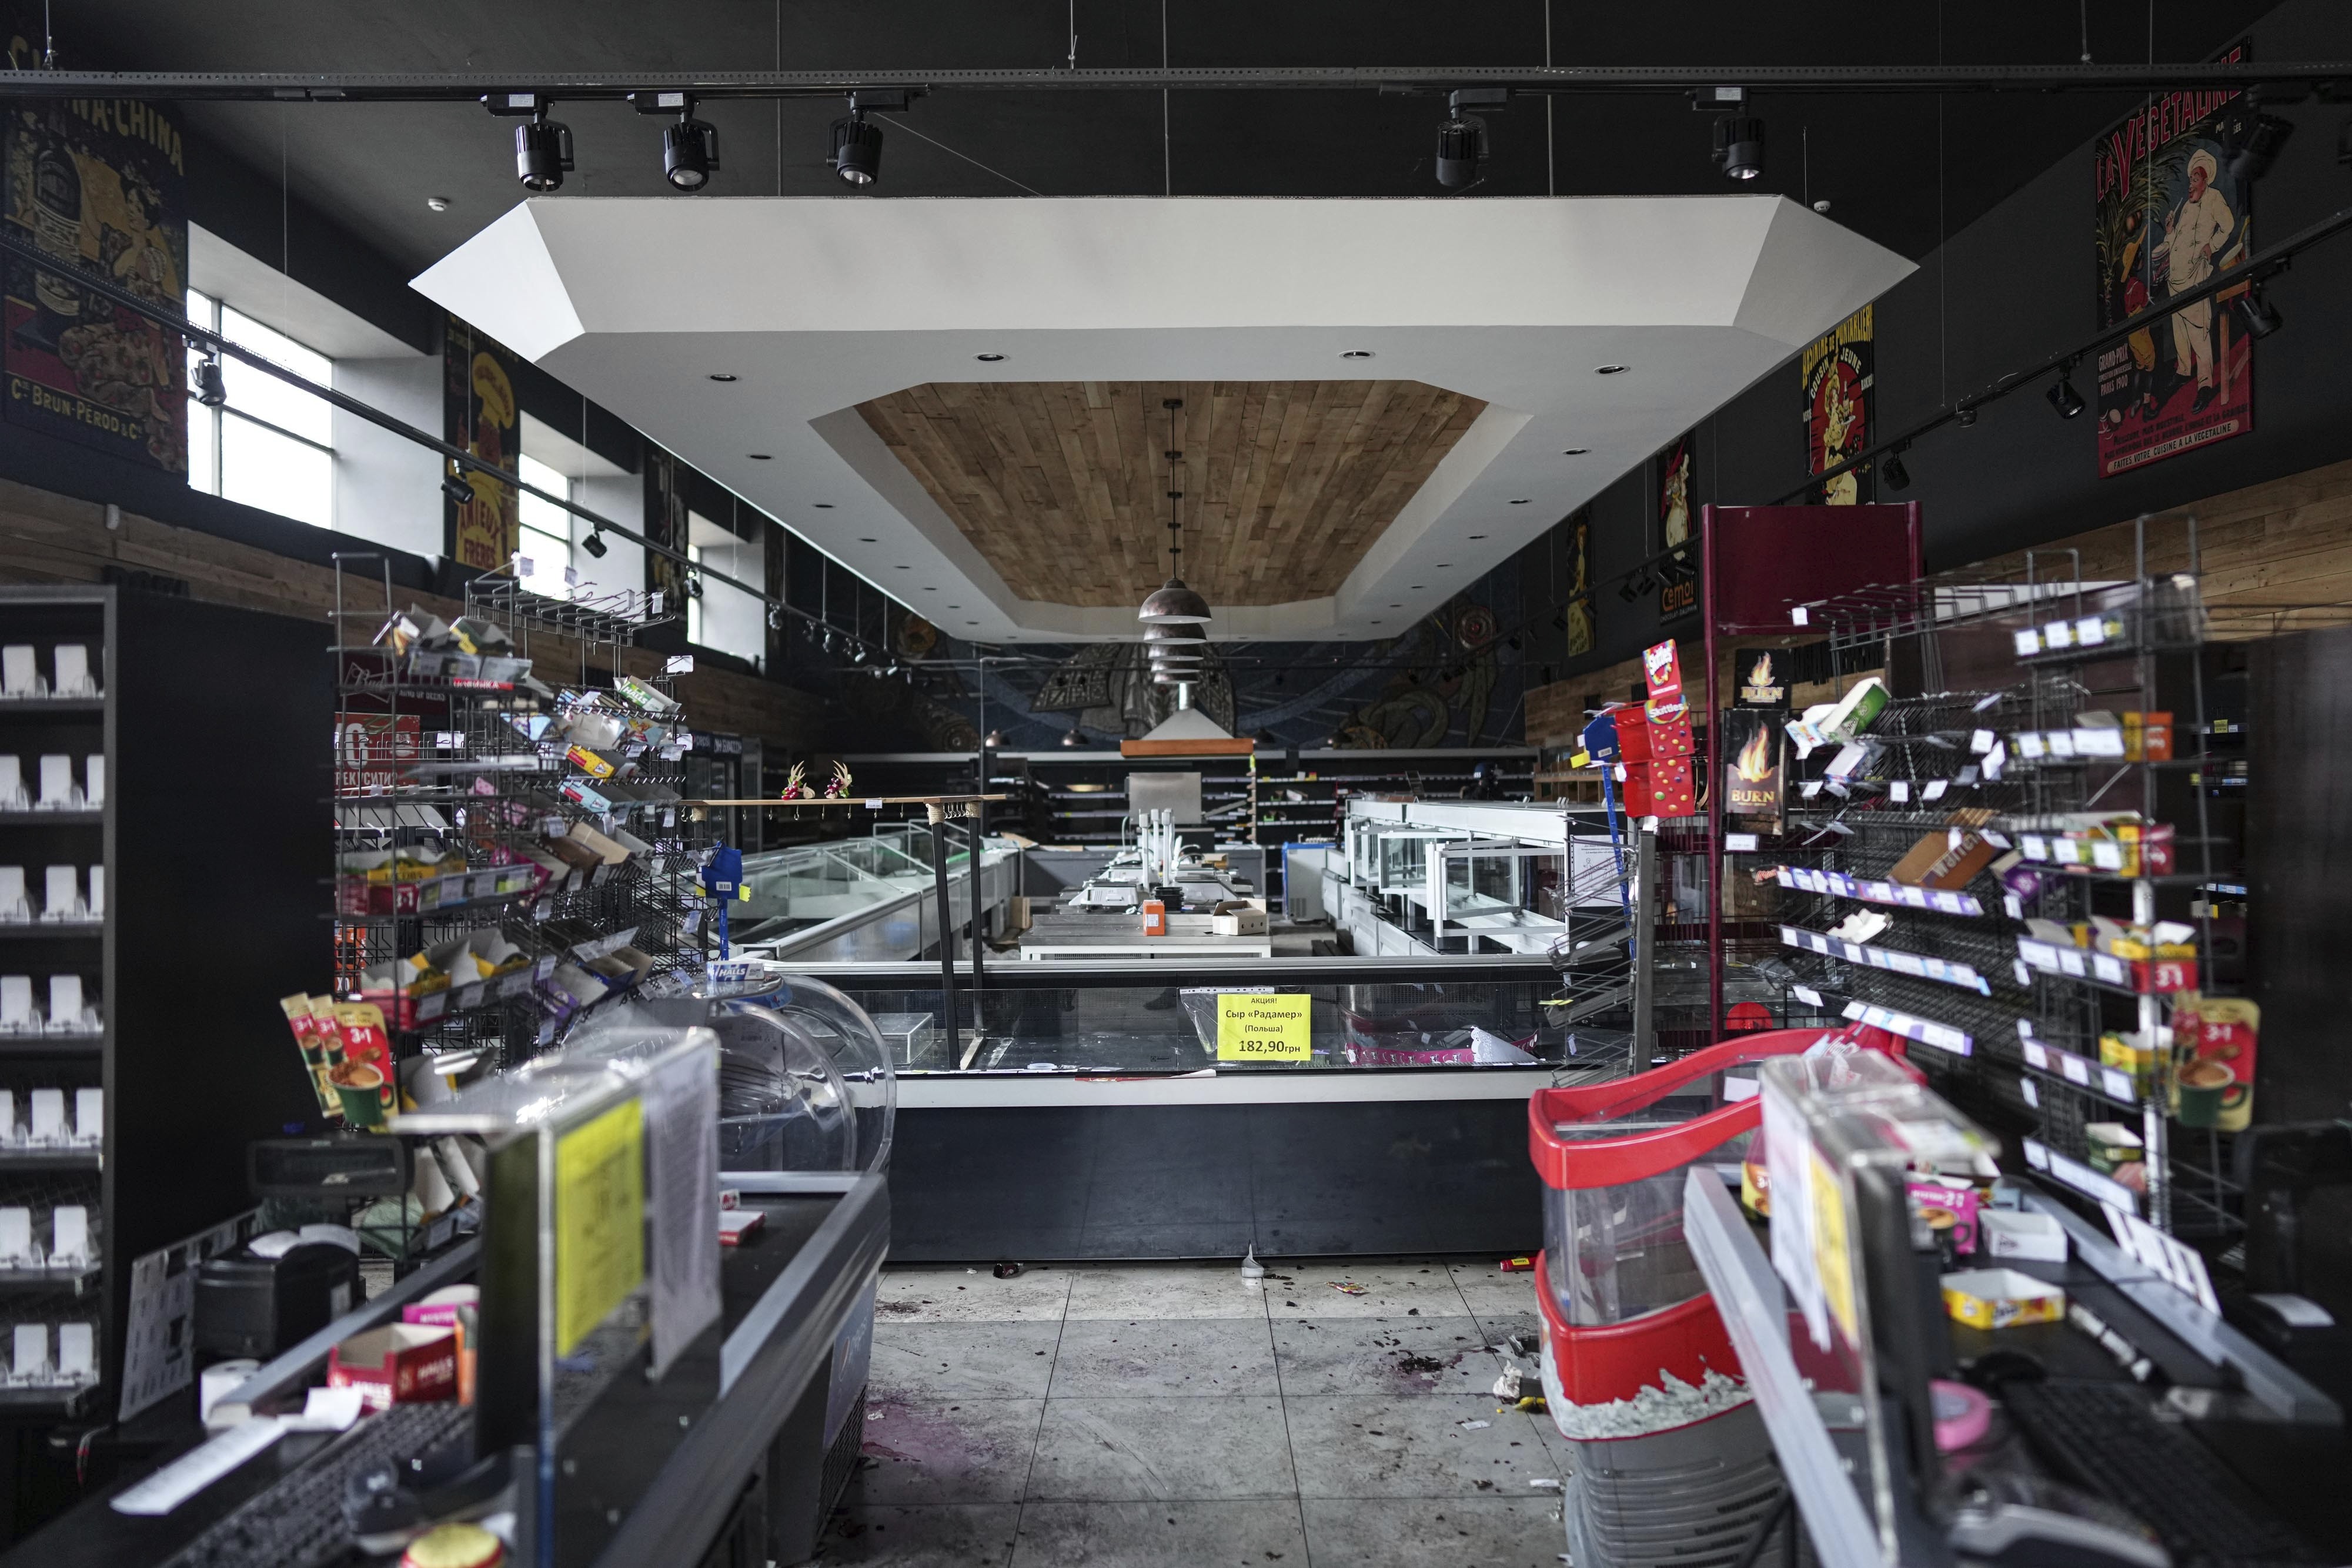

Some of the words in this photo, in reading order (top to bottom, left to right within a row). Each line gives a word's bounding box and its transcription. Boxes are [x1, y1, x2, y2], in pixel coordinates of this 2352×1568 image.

[2096, 154, 2115, 203] LA
[1810, 356, 1830, 400] COUSIN
[1840, 347, 1862, 376] JEUNE
[2100, 379, 2115, 397] PARIS
[2116, 374, 2129, 390] 1900
[2113, 456, 2133, 470] FAITES
[2133, 450, 2151, 463] VOTRE
[2153, 441, 2177, 456] CUISINE
[2184, 436, 2193, 445] LA
[624, 687, 647, 705] HALLS
[1740, 686, 1785, 700] BURN
[1648, 703, 1689, 718] Skittles
[1730, 790, 1775, 803] BURN
[717, 967, 746, 977] HALLS
[1225, 1009, 1245, 1020] Сыр
[1248, 1009, 1302, 1020] «Радамер»
[1245, 1024, 1283, 1034] (Польша)
